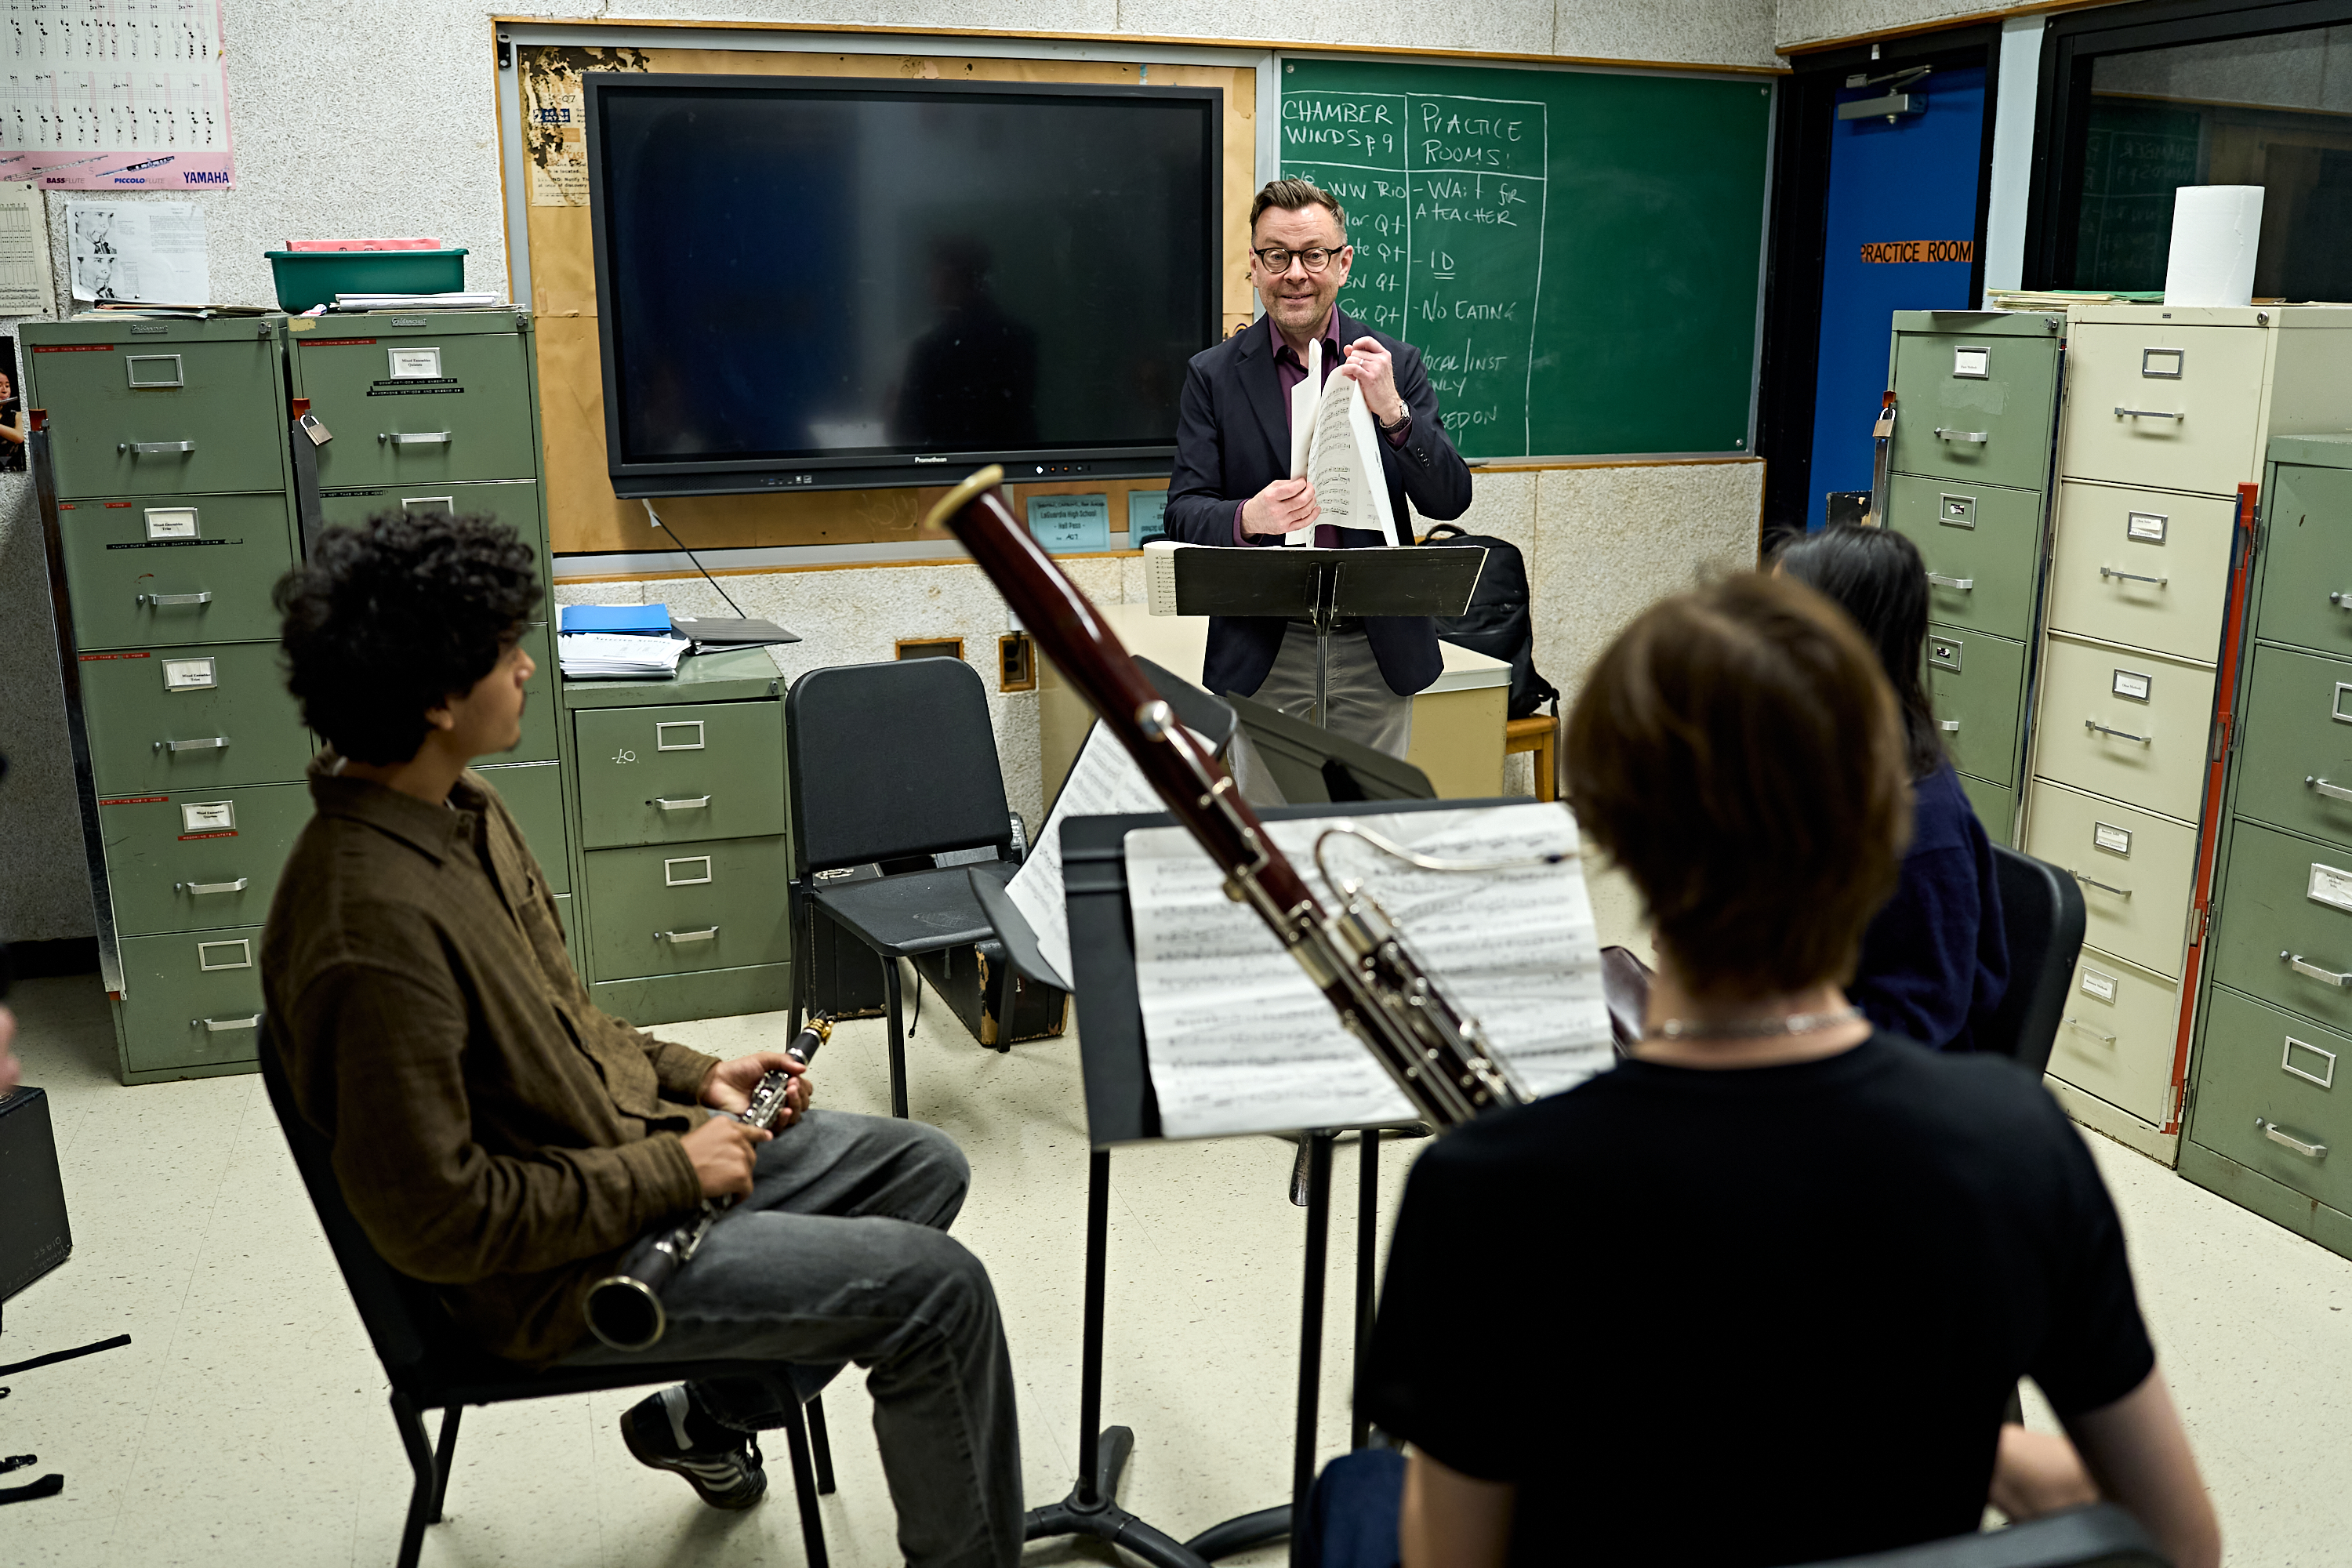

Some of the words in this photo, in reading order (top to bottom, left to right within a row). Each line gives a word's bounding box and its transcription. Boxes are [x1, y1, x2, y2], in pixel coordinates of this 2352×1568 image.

[1282, 100, 1393, 125] CHAMBER
[1284, 125, 1362, 147] WINDS
[1382, 133, 1393, 153] 9
[183, 171, 230, 183] YAMAHA
[1860, 242, 1920, 263] PRACTICE
[1927, 241, 1972, 262] ROOM
